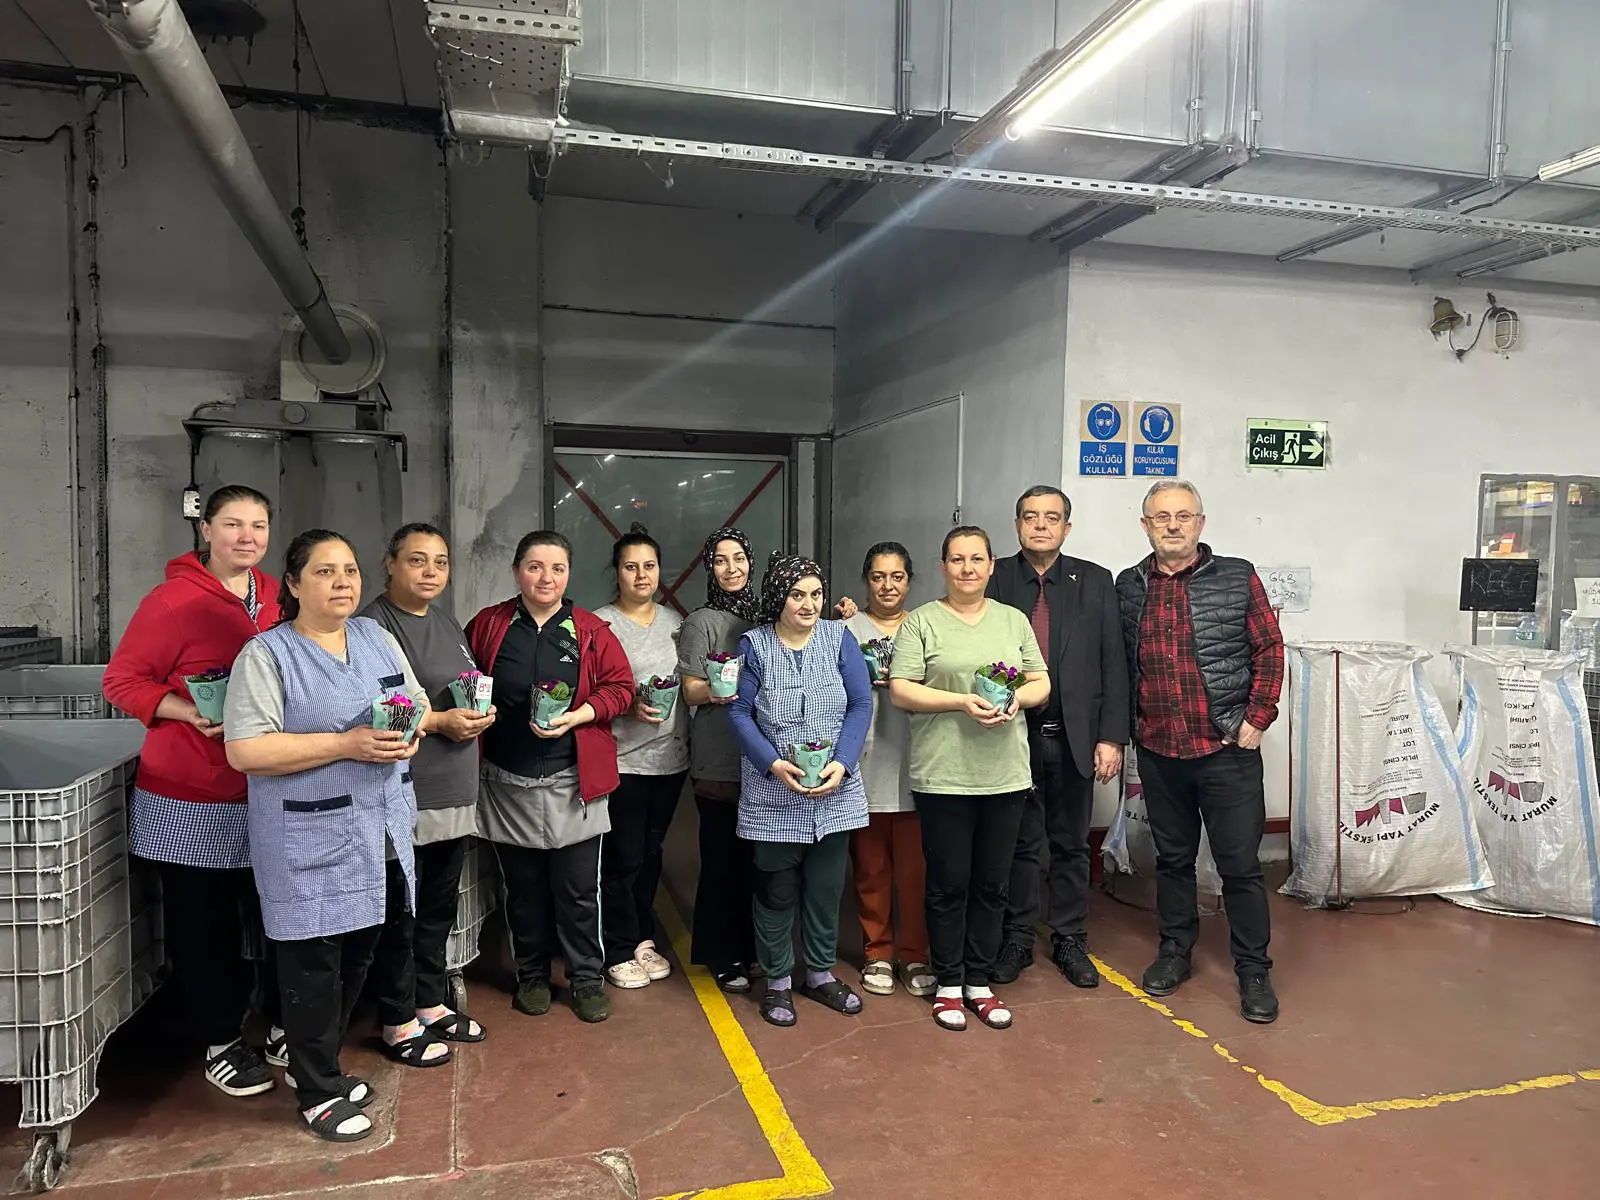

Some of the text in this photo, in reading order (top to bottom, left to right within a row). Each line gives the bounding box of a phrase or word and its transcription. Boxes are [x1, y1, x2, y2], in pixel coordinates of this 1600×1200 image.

[1255, 433, 1276, 444] Acil
[1098, 443, 1107, 453] İŞ
[1146, 445, 1165, 454] KULAK
[1252, 446, 1279, 460] Çıkış
[1082, 454, 1123, 464] GÖZLÜĞÜ
[1134, 456, 1176, 465] KORUYUCUSUNU
[1085, 465, 1119, 474] KULLAN
[1145, 467, 1165, 475] TAKINIZ
[1401, 740, 1416, 748] LOT
[1521, 796, 1558, 822] MURAT
[1406, 802, 1441, 833] MURAT
[1376, 828, 1405, 841] YAPI
